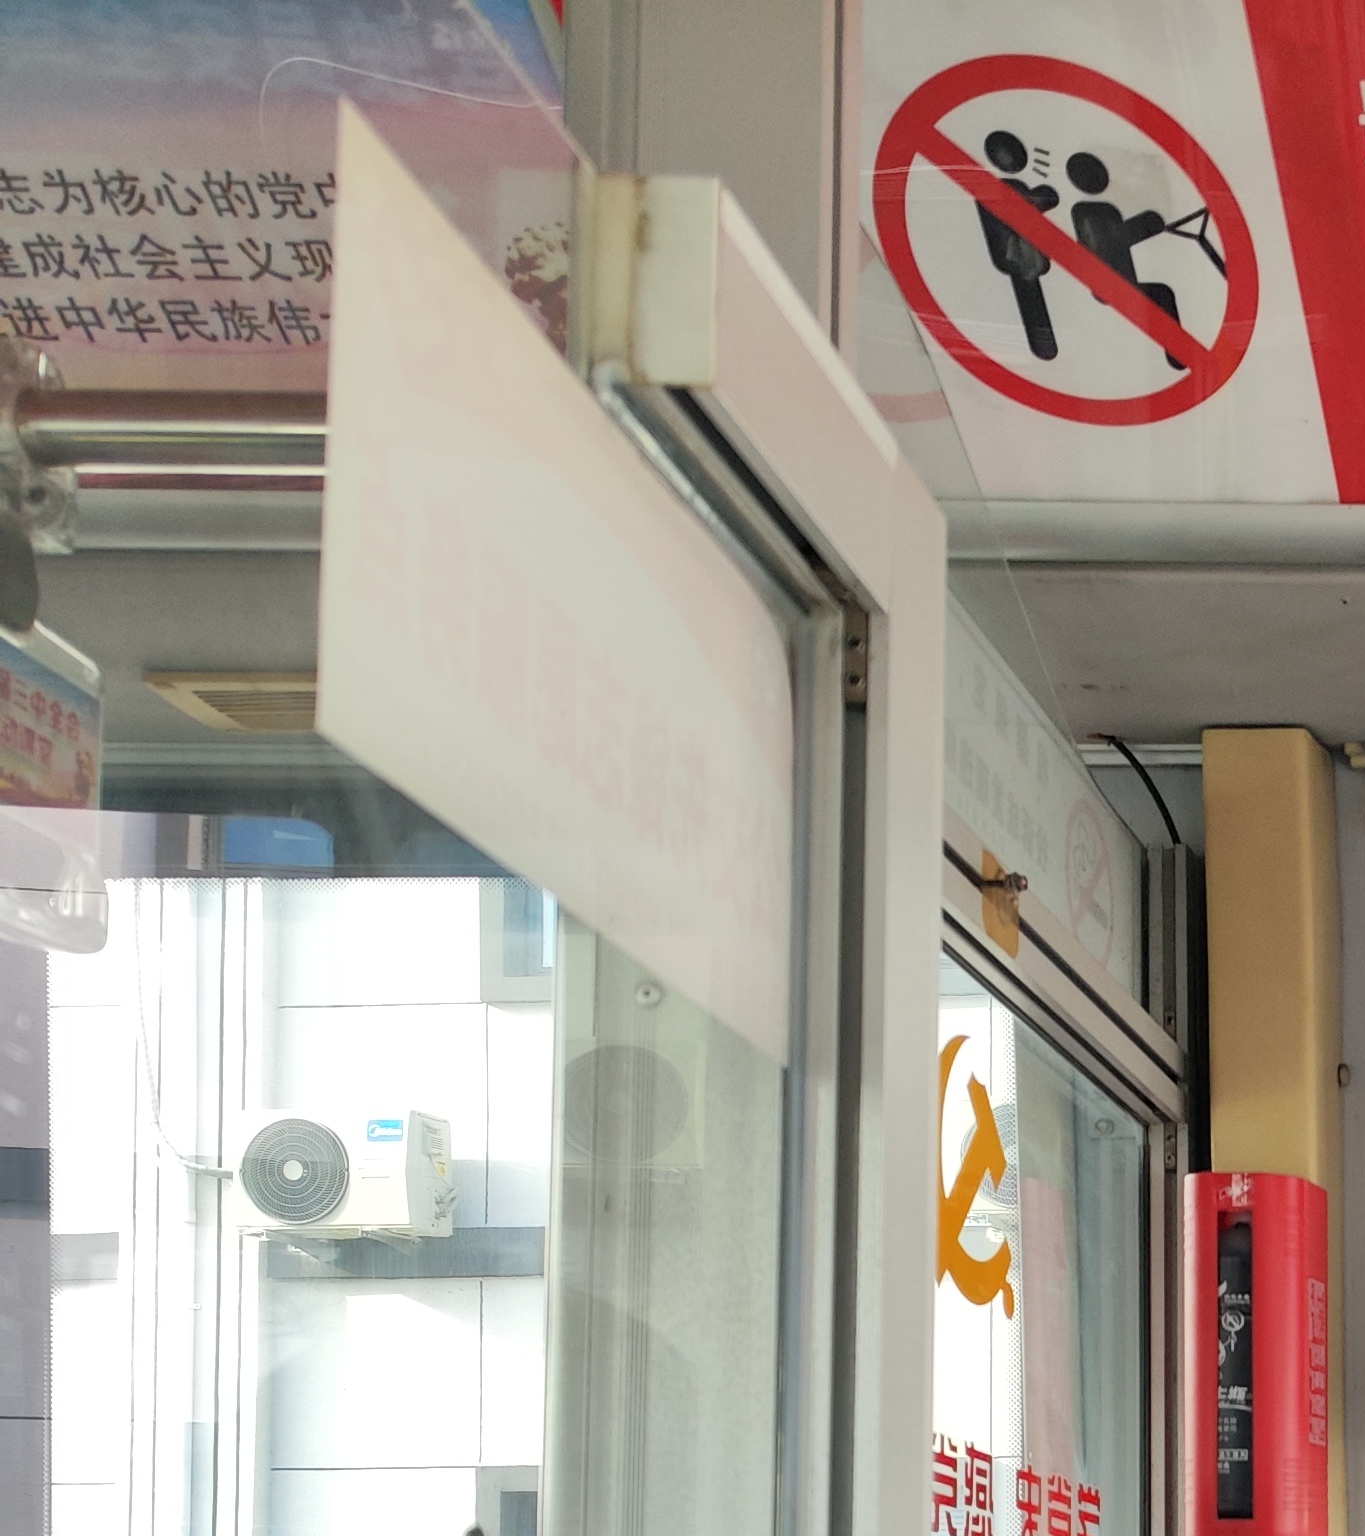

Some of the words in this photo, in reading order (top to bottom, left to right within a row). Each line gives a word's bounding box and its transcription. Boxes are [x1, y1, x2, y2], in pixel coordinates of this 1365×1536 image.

[0, 297, 331, 345] 进中华民族伟
